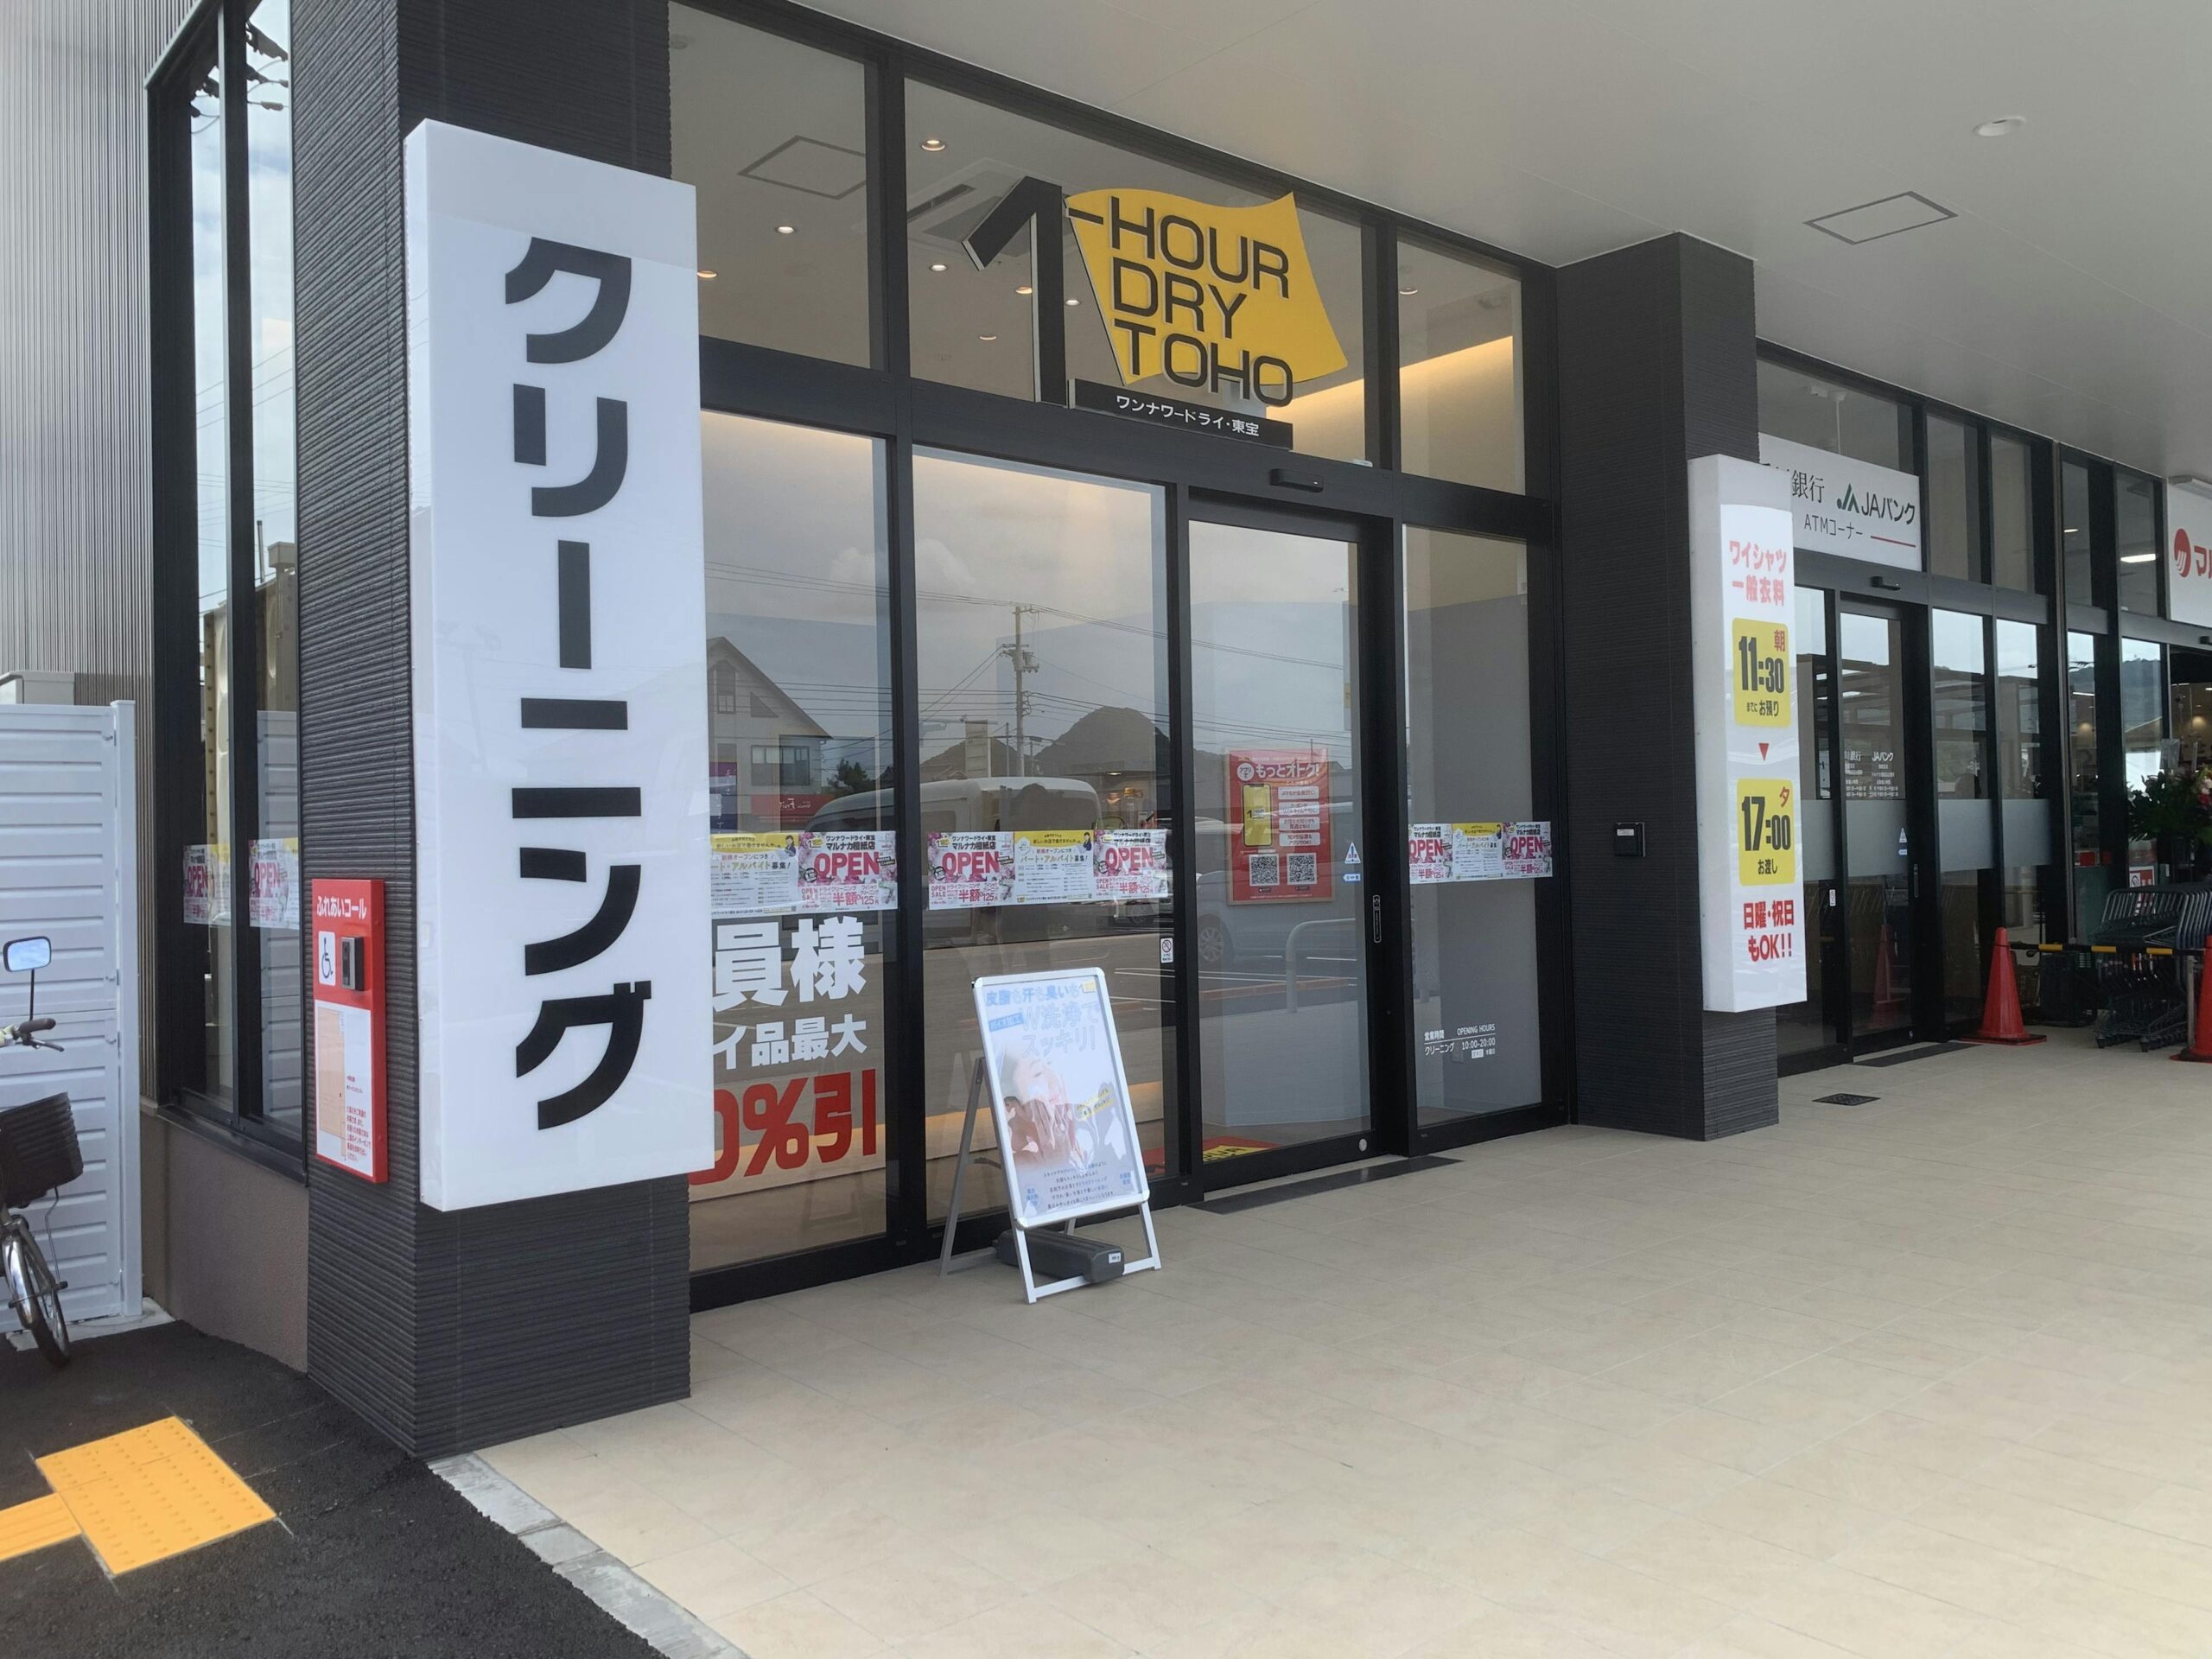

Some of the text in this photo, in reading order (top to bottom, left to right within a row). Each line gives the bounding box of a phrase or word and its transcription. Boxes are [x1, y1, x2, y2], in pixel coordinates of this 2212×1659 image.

[1113, 257, 1247, 339] DRY
[1114, 318, 1293, 407] TOHO
[1116, 395, 1260, 436] ワンナワードライ・東宝
[1804, 513, 1863, 539] ATMコーナー
[1729, 540, 1787, 573] ワイシャツ
[1732, 575, 1785, 607] 一般衣料
[1774, 629, 1786, 652] 朝
[1738, 636, 1784, 693] 11:30
[505, 236, 652, 1129] クリーニング
[1742, 796, 1791, 851] 17:00
[1105, 847, 1154, 871] OPEN
[1408, 838, 1443, 857] OPEN
[1511, 836, 1543, 855] OPEN
[188, 866, 208, 888] OPEN
[254, 862, 280, 890] OPEN
[814, 851, 880, 877] OPEN
[942, 851, 1000, 876] OPEN
[1758, 859, 1778, 874] お渡し
[317, 896, 366, 920] ふれあいコール
[1743, 899, 1795, 930] 日曜・祝日
[1748, 933, 1792, 962] もOK!!
[713, 915, 867, 1012] 員様
[713, 1014, 867, 1070] イ品最大
[1022, 1025, 1096, 1058] スッキリ!
[1457, 1026, 1478, 1036] OPENING
[1479, 1023, 1496, 1033] HOURS
[1424, 1038, 1496, 1056] クリーニング 10:00-20:00
